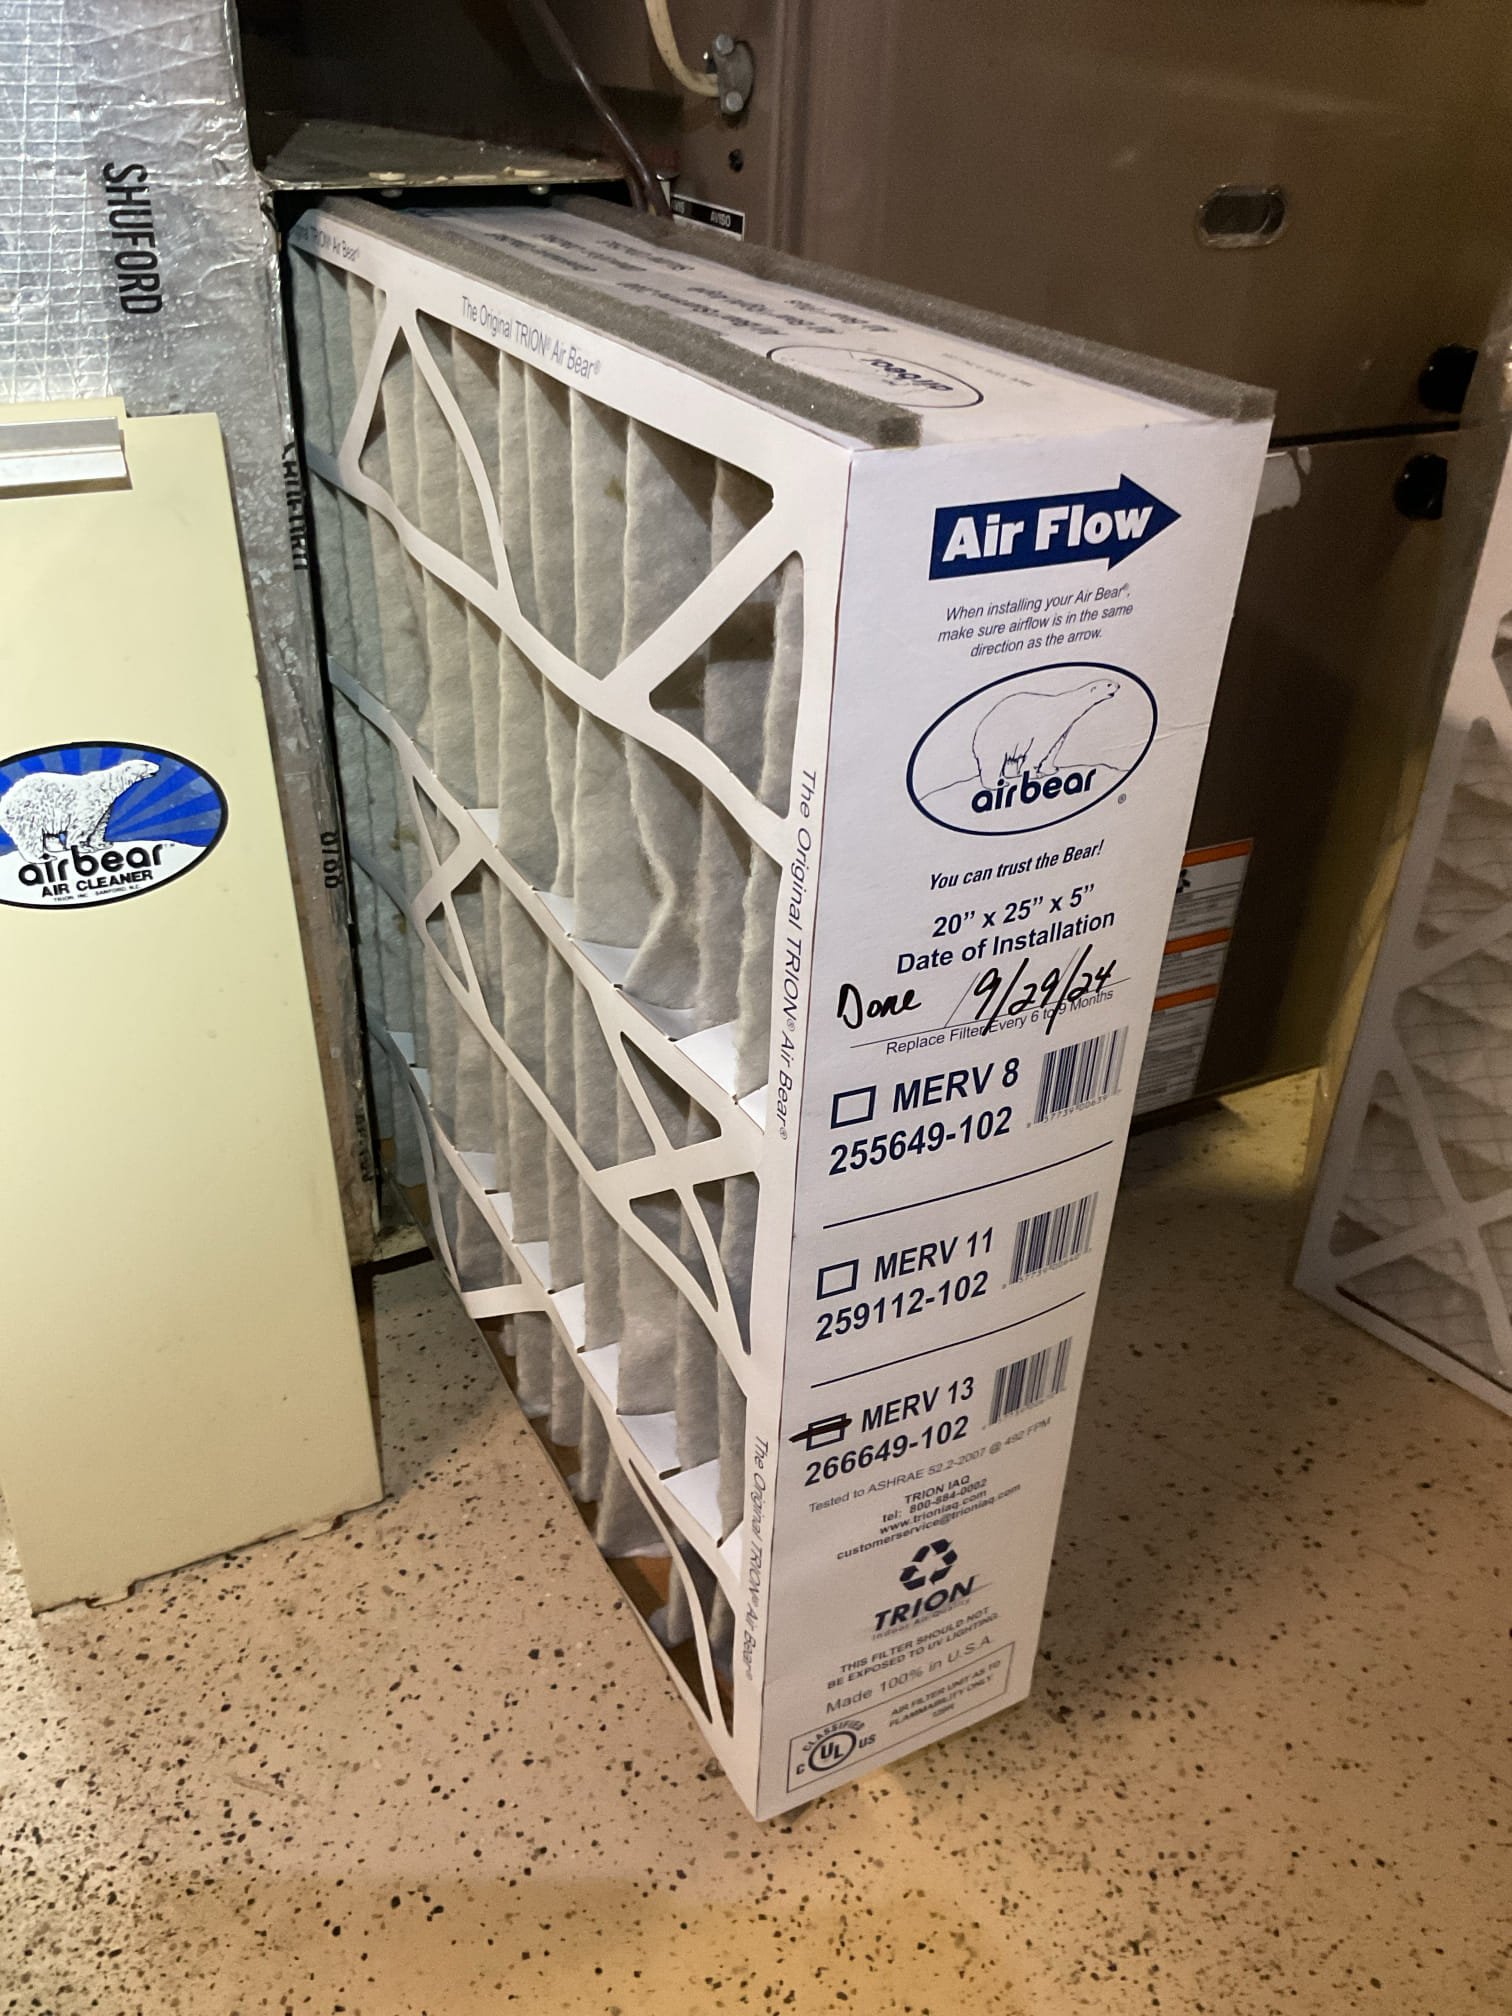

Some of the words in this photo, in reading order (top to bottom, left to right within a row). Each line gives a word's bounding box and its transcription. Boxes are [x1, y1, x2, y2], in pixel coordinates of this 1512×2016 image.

[102, 162, 163, 314] SHUFORD
[462, 296, 477, 321] The
[480, 305, 512, 340] Original
[552, 340, 567, 365] Air
[942, 512, 1025, 563] Air
[1035, 504, 1154, 552] Flow
[938, 627, 974, 643] make
[977, 624, 1006, 638] sure
[1009, 616, 1050, 633] airflow
[1052, 613, 1062, 627] is
[1066, 611, 1077, 624] in
[1080, 607, 1099, 623] the
[1101, 603, 1133, 619] same
[946, 606, 984, 622] When
[987, 597, 1042, 615] installing
[1045, 593, 1073, 612] your
[1075, 589, 1093, 605] Air
[970, 638, 1024, 657] direction
[1027, 637, 1042, 649] as
[1045, 632, 1064, 647] the
[1067, 628, 1102, 643] arrow.
[800, 769, 817, 818] The
[971, 769, 1097, 813] airbear
[18, 844, 163, 886] airbear
[42, 883, 70, 898] AIR
[76, 870, 153, 892] CLEANER
[789, 828, 812, 931] Original
[930, 873, 959, 890] You
[963, 867, 993, 884] can
[997, 858, 1032, 878] trust
[1036, 852, 1059, 870] the
[1062, 839, 1105, 864] Bear!
[982, 911, 997, 928] x
[1049, 896, 1063, 913] x
[897, 950, 953, 975] Date
[961, 938, 988, 962] of
[993, 912, 1115, 956] Installation
[837, 983, 922, 1030] Done
[974, 944, 1117, 1036] 9/29/24
[886, 1033, 945, 1055] Replace
[949, 1023, 985, 1042] Filter
[989, 1014, 1028, 1034] Every
[1030, 1010, 1039, 1022] 6
[1043, 1007, 1052, 1020] to
[1059, 1003, 1067, 1016] 9
[1070, 989, 1114, 1013] Months
[781, 1031, 795, 1068] Air
[892, 1062, 995, 1113] MERV
[1002, 1057, 1020, 1088] 8
[828, 1105, 1013, 1176] 255649-102
[874, 1236, 959, 1283] MERV
[967, 1226, 994, 1258] 11
[815, 1270, 989, 1342] 259112-102
[861, 1386, 940, 1433] MERV
[948, 1376, 975, 1405] 13
[754, 1436, 768, 1469] The
[804, 1415, 969, 1487] 266649-102
[808, 1493, 851, 1514] Tested
[853, 1488, 865, 1500] to
[868, 1469, 924, 1494] ASHRAE
[1004, 1430, 1025, 1446] 492
[1026, 1416, 1052, 1437] FPM
[750, 1473, 766, 1542] Original
[879, 1490, 988, 1535] www.trioniaq.com
[905, 1483, 945, 1504] TRION
[948, 1475, 971, 1490] IAQ
[836, 1483, 1021, 1560] customerservice@trioniaq.com
[882, 1509, 902, 1524] tel:
[746, 1602, 759, 1631] Air
[875, 1575, 976, 1631] TRION
[827, 1678, 844, 1690] BE
[848, 1654, 906, 1682] EXPOSED
[909, 1646, 925, 1658] TO
[927, 1638, 944, 1651] UV
[840, 1658, 868, 1673] THIS
[871, 1641, 913, 1663] FILTER
[916, 1619, 964, 1645] SHOULD
[966, 1606, 989, 1622] NOT
[826, 1687, 873, 1714] Made
[880, 1667, 924, 1692] 100%
[929, 1660, 942, 1673] in
[889, 1689, 964, 1728] FLAMMABILITY
[891, 1703, 909, 1715] AIR
[911, 1687, 946, 1708] FILTER
[971, 1667, 986, 1679] AS
[796, 1763, 805, 1775] C
[821, 1742, 844, 1759] UL
[859, 1734, 876, 1749] US
[802, 1720, 865, 1752] CLASSIFIED
